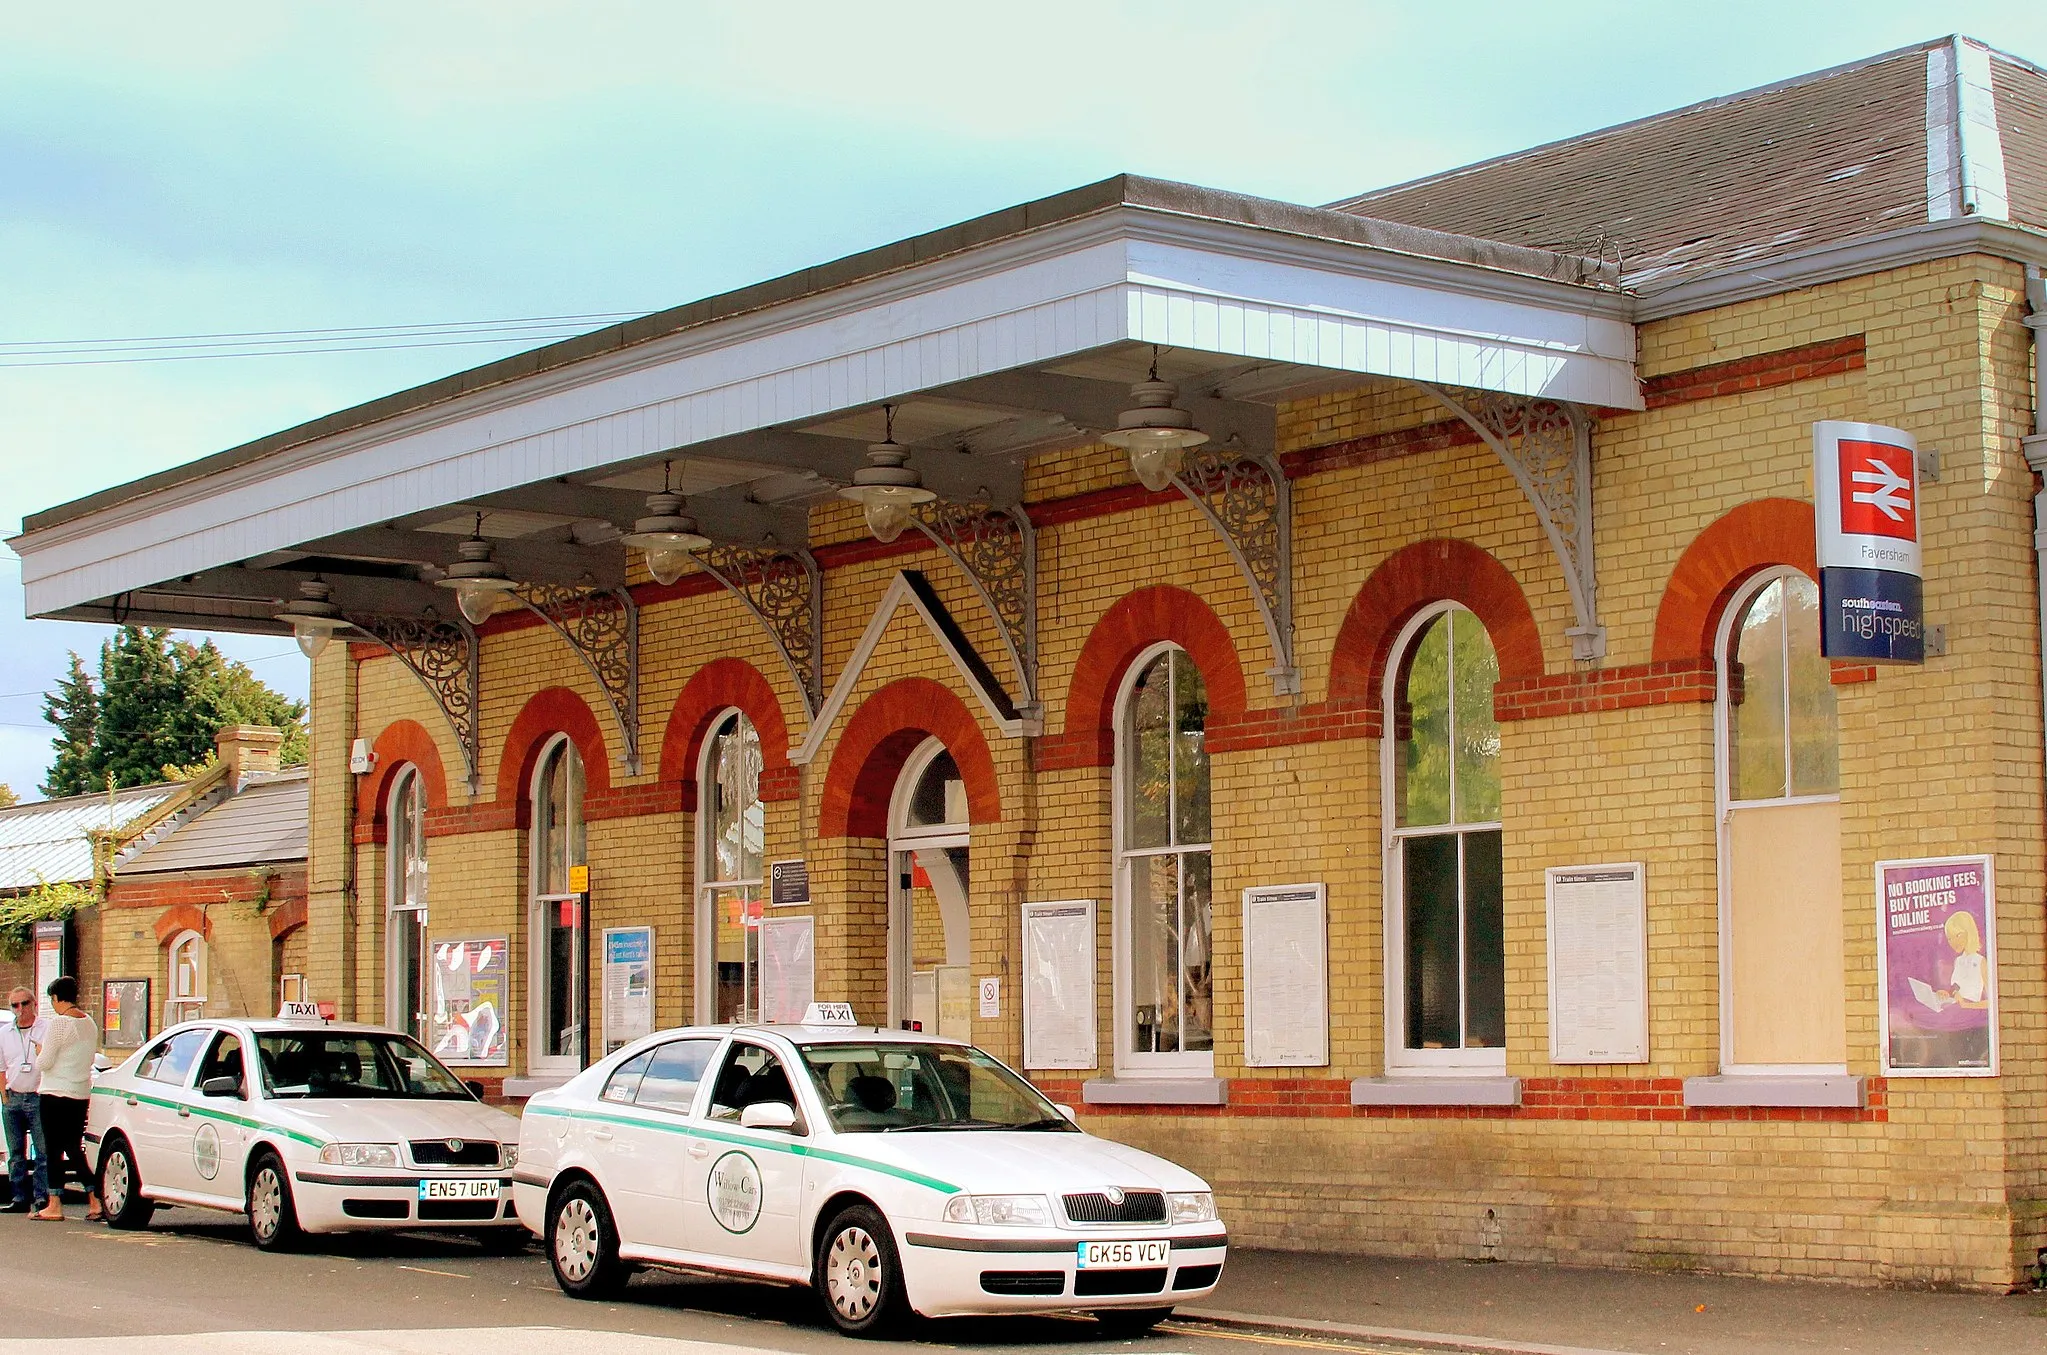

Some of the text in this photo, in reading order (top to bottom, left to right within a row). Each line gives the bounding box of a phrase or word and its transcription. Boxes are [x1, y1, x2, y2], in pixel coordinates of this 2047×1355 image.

[1860, 545, 1910, 563] Faversham
[1842, 609, 1921, 641] highspeed
[1887, 871, 1980, 897] NO BOOKING FEES,
[1889, 890, 1956, 913] BUY TICKETS
[1891, 909, 1930, 928] ONLINE
[288, 1003, 316, 1015] TAXI
[819, 1010, 850, 1020] TAXI
[429, 1182, 497, 1197] EN57 URV
[714, 1170, 739, 1191] Willow
[1089, 1243, 1167, 1263] GK56 VCV
